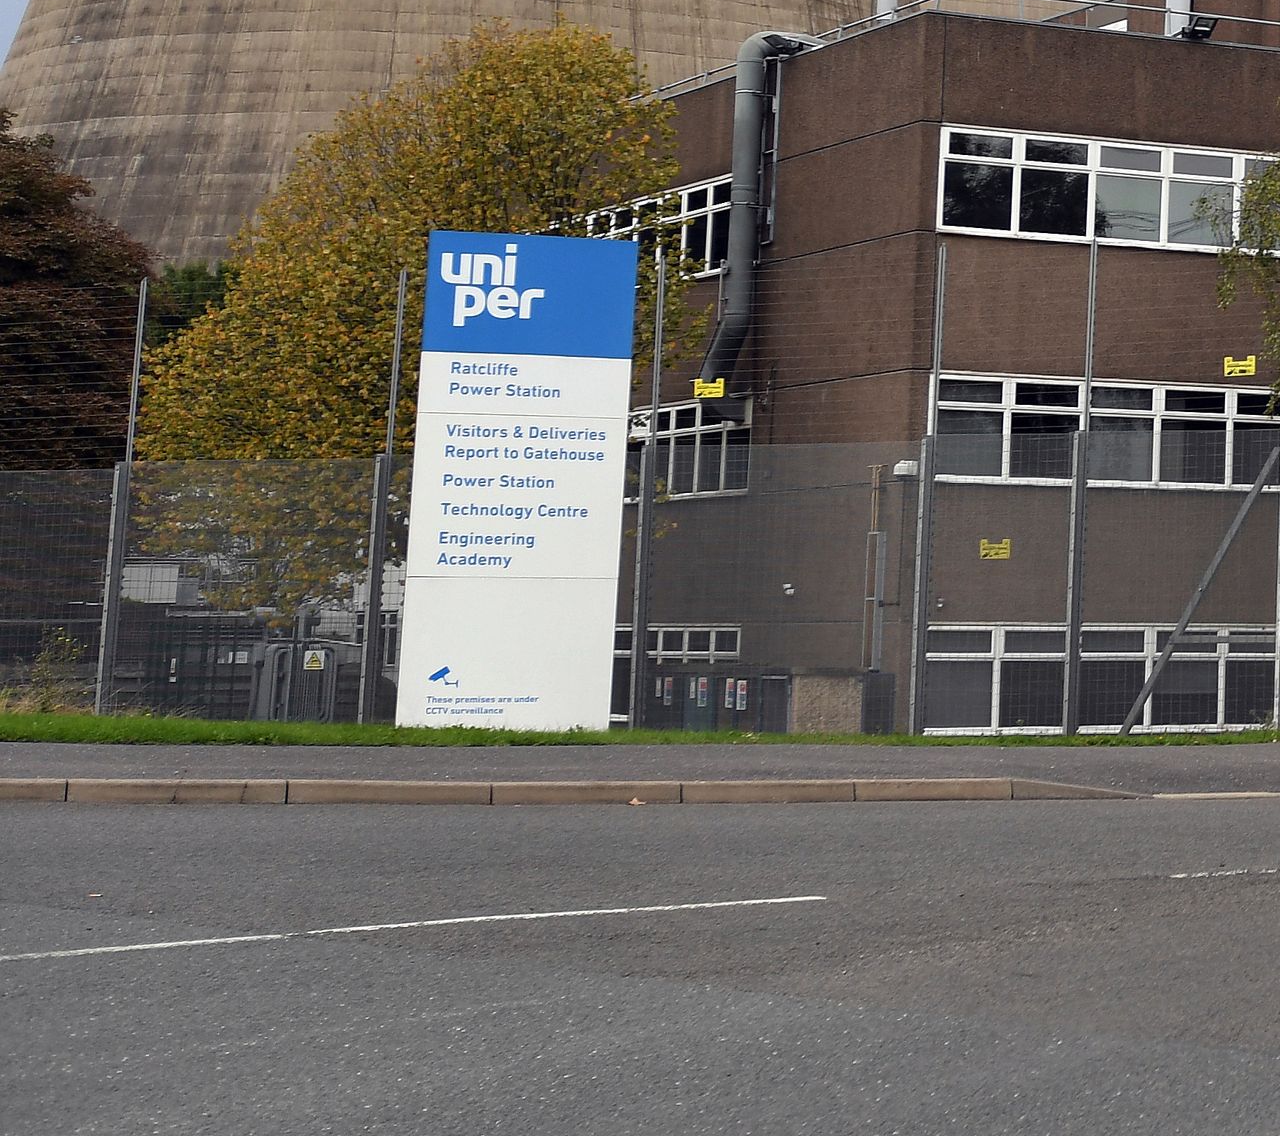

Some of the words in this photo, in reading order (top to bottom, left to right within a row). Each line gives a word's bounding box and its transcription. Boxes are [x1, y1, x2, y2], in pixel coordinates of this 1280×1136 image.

[440, 243, 517, 286] uni
[453, 285, 544, 327] per
[450, 362, 518, 376] Ratcliffe
[449, 383, 500, 396] Power
[505, 384, 561, 398] Station
[446, 425, 508, 439] Visitors
[513, 426, 523, 439] &
[528, 426, 606, 441] Deliveries
[445, 445, 499, 461] Report
[503, 447, 518, 459] to
[523, 448, 604, 462] Gatehouse
[443, 475, 495, 487] Power
[499, 475, 554, 489] Station
[441, 503, 533, 520] Technology
[537, 505, 588, 518] Centre
[439, 532, 535, 548] Engineering
[437, 553, 512, 568] Academy
[426, 695, 452, 703] These
[455, 696, 494, 706] premises
[514, 694, 539, 703] under
[425, 706, 447, 715] CCTV
[450, 706, 503, 715] surveillance
